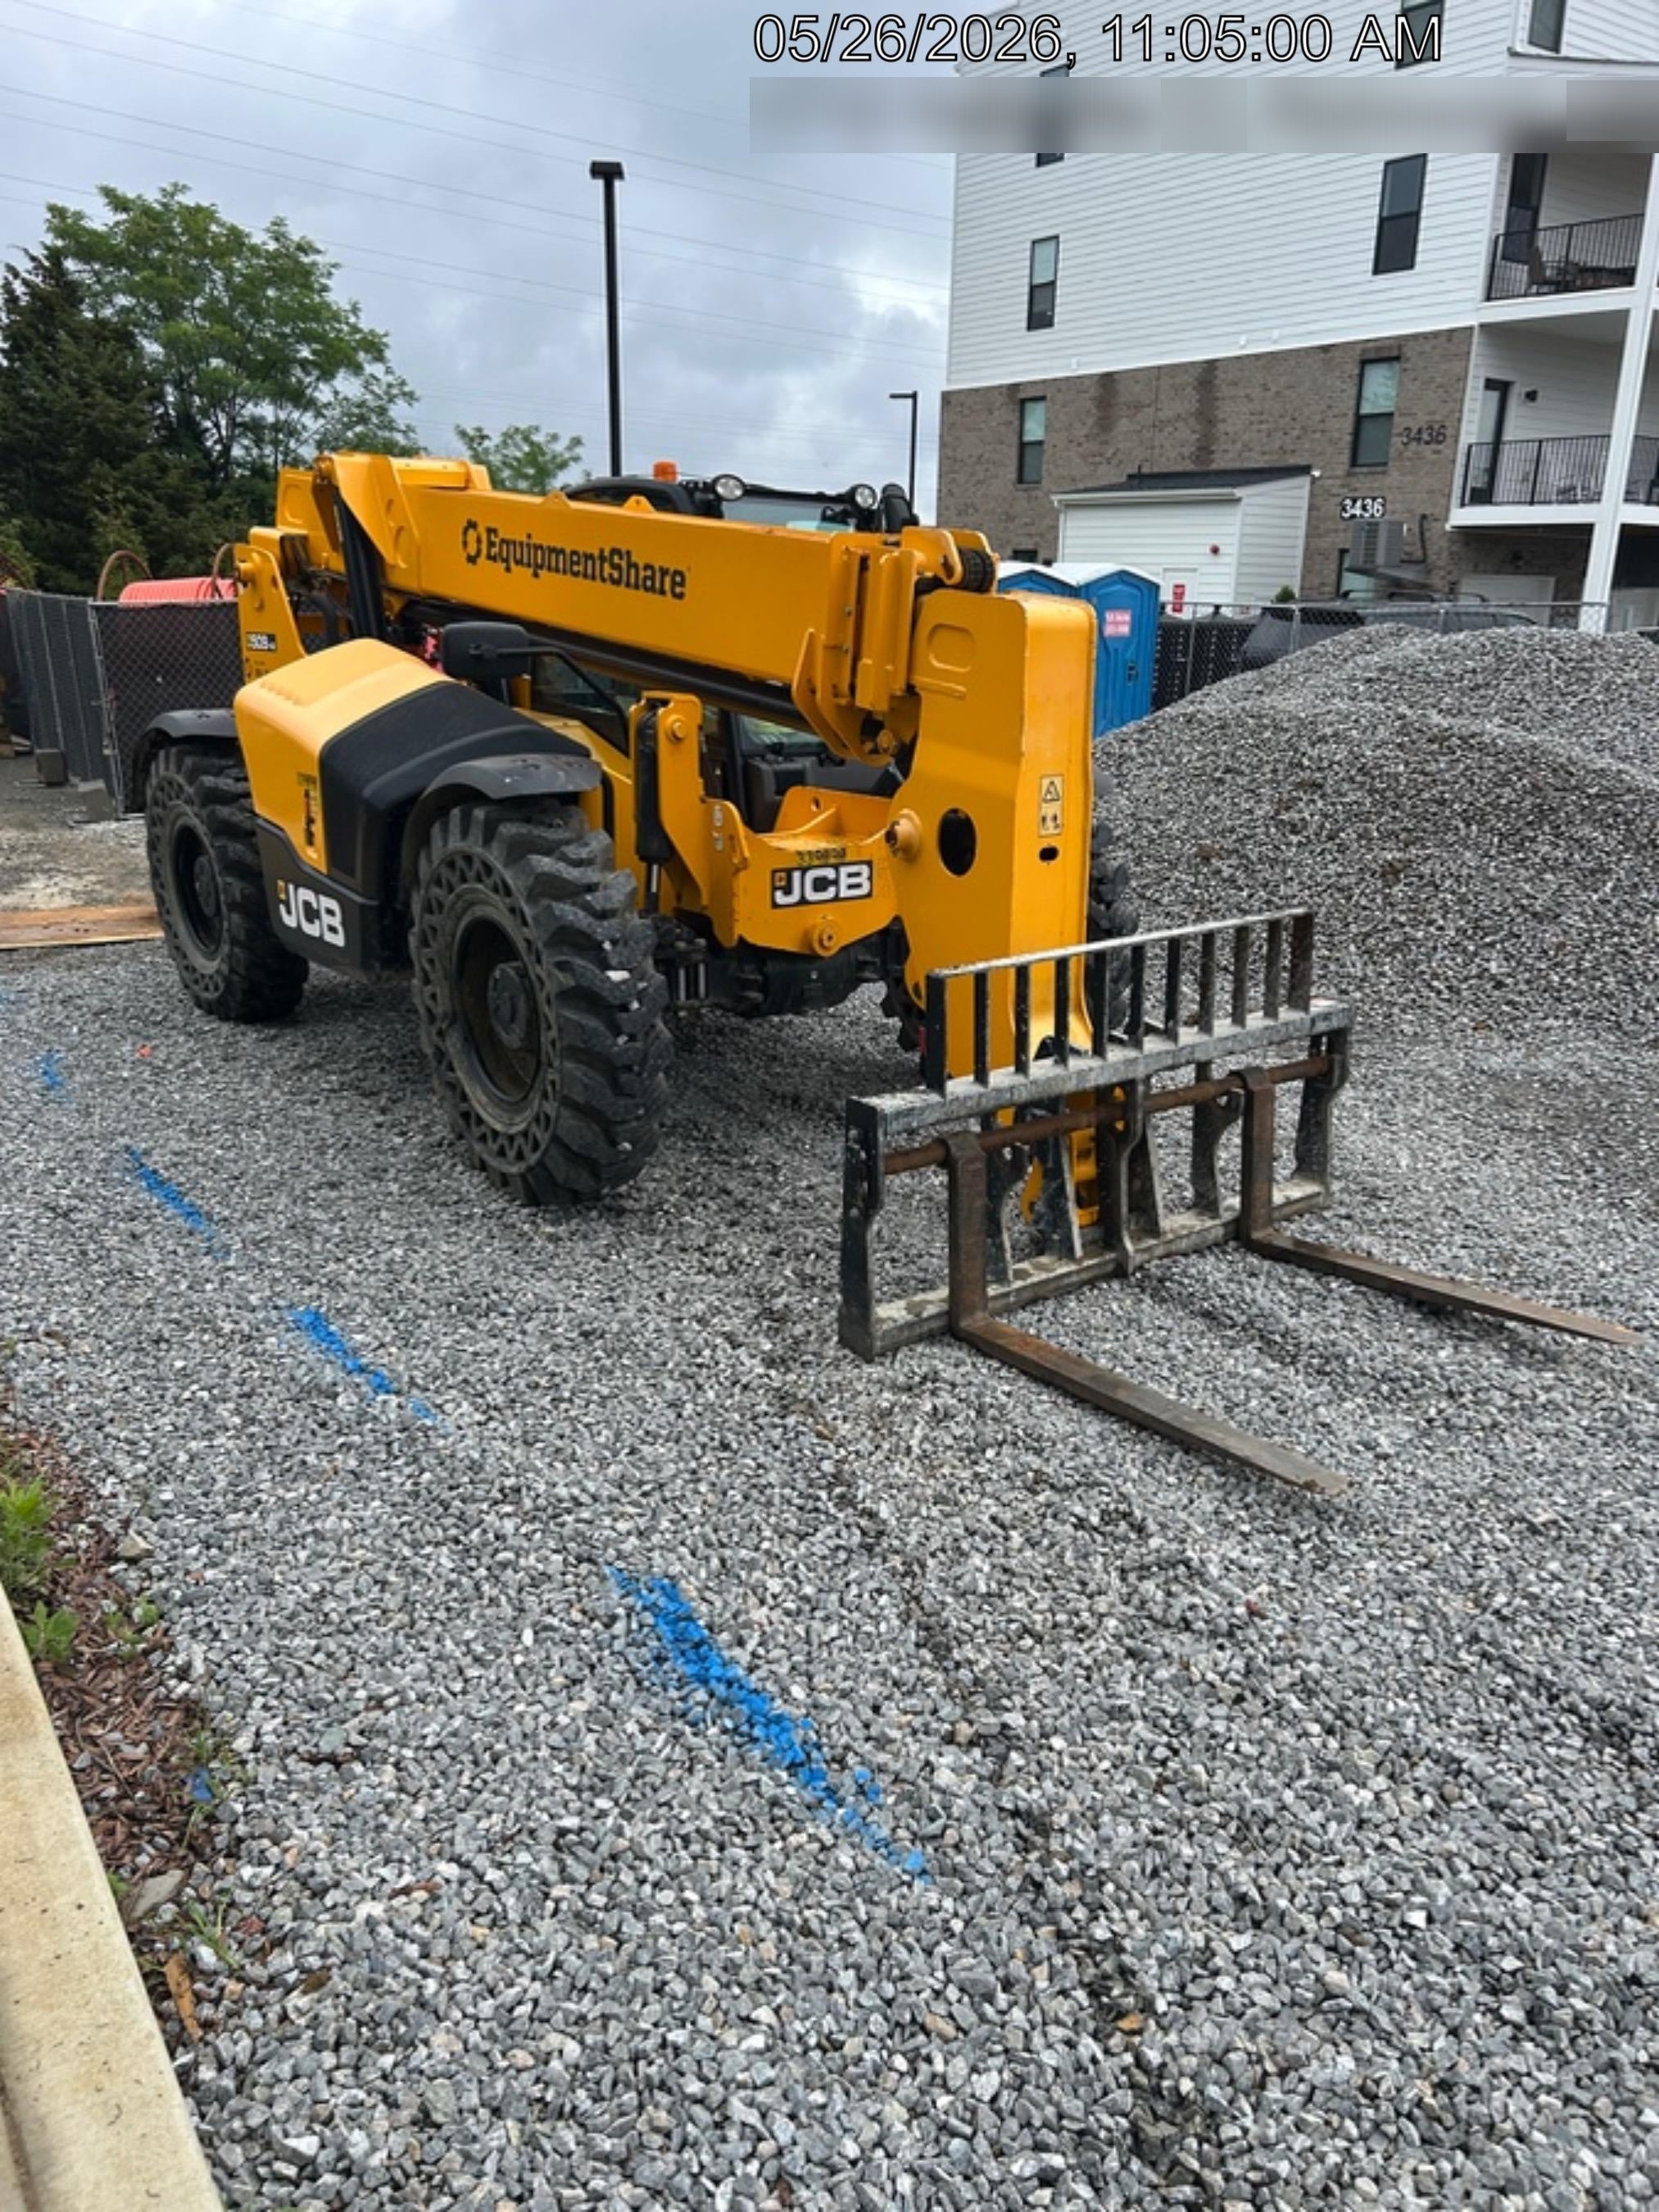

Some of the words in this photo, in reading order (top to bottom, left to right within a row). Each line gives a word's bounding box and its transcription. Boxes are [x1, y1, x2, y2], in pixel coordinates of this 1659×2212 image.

[1401, 424, 1448, 446] 3436
[1341, 497, 1385, 518] 3436
[485, 525, 687, 601] EquipmentShare
[774, 864, 871, 905] JCB
[279, 883, 345, 947] JCB
